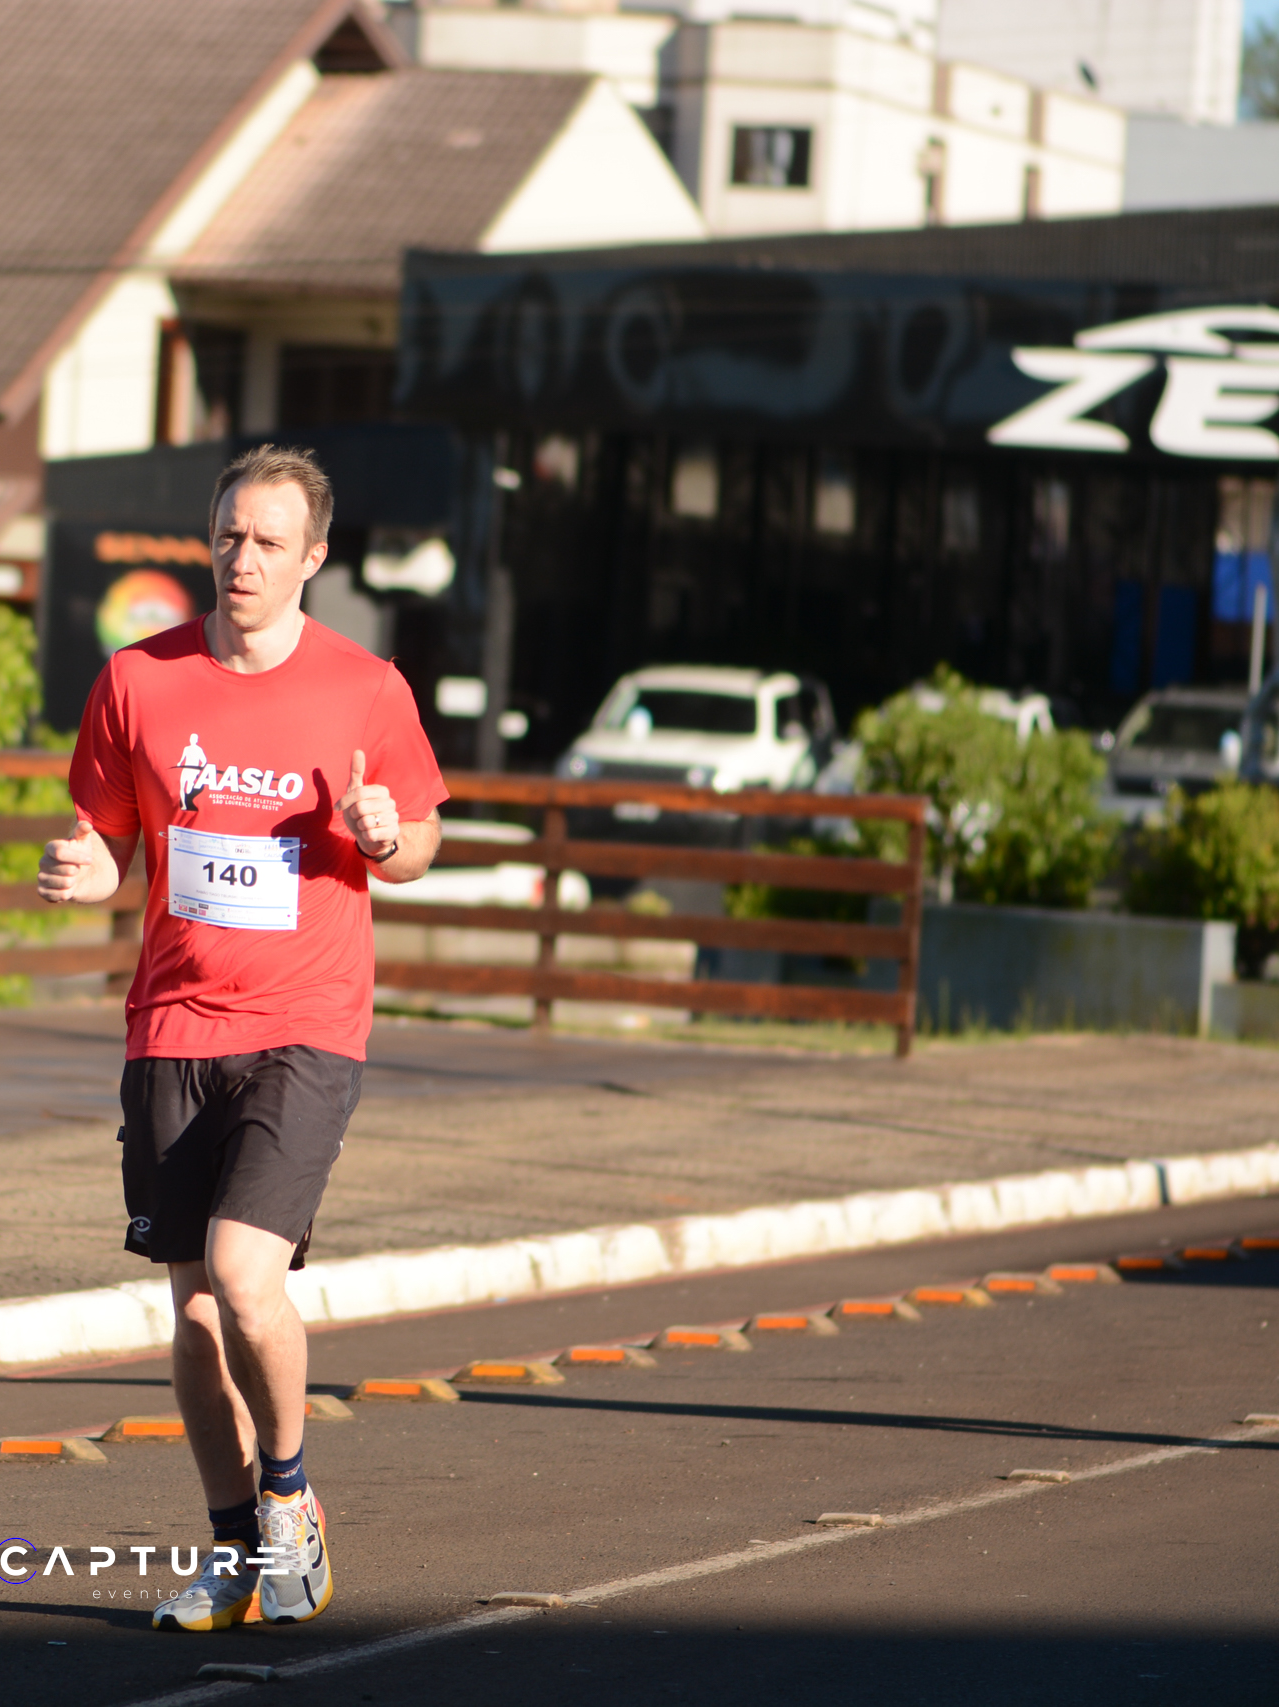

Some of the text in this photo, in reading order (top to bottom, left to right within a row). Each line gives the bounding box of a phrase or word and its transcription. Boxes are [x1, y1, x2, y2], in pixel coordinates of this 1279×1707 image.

[193, 763, 304, 800] AASLO
[208, 793, 243, 802] ASSOCIAÇÃO
[253, 798, 283, 807] ATLETISMO
[224, 800, 252, 808] LOURENÇO
[202, 861, 258, 887] 140
